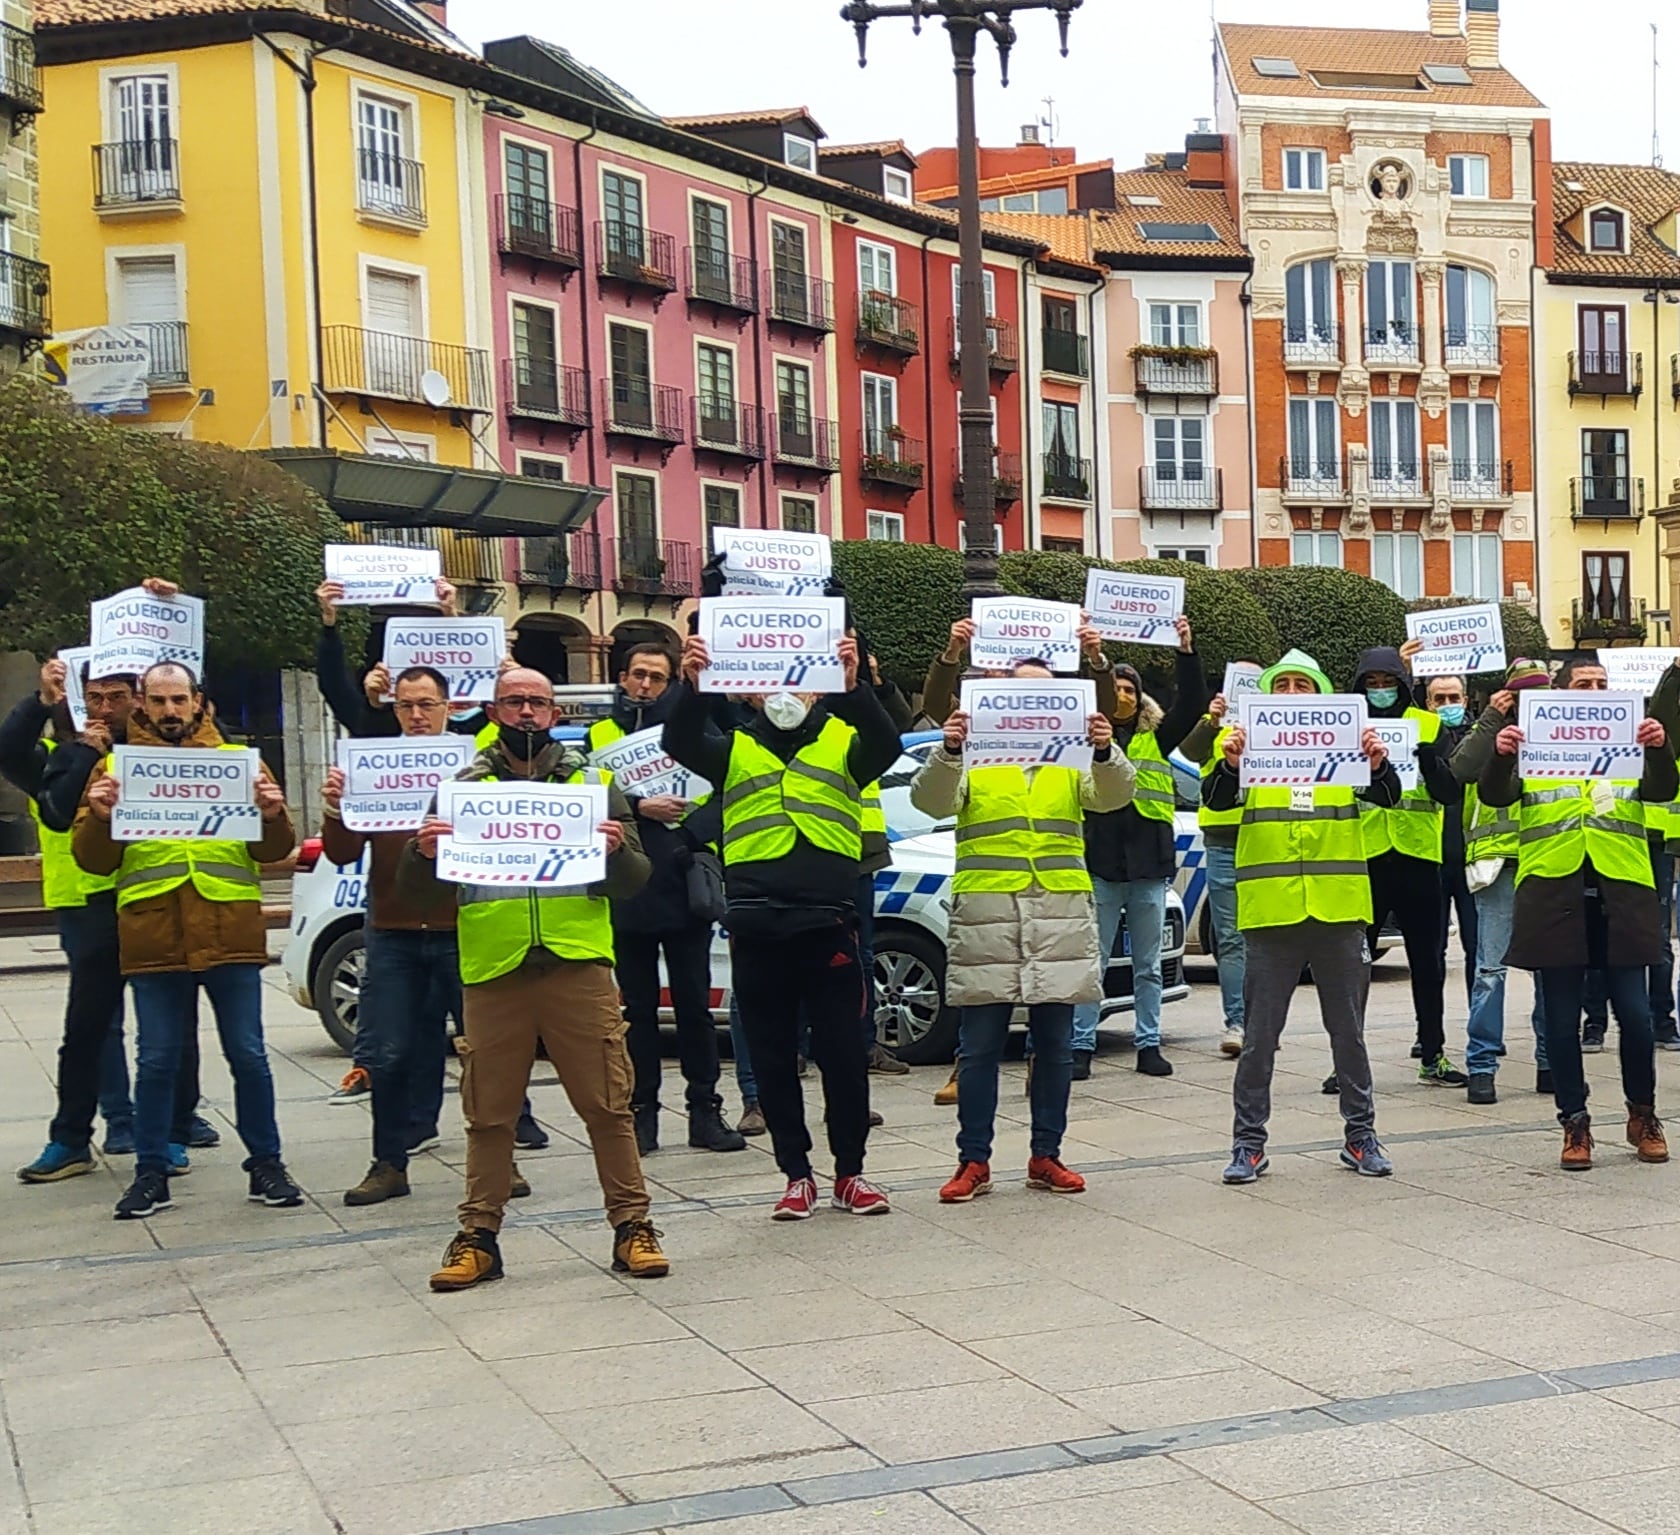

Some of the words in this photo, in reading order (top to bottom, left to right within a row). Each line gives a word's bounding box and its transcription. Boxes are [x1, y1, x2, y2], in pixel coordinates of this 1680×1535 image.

[730, 540, 814, 556] ACUERDO
[356, 563, 408, 573] JUSTO
[745, 556, 801, 571] JUSTO
[726, 575, 756, 585] olicía
[758, 578, 785, 589] Local
[1100, 583, 1170, 601] ACUERDO
[105, 603, 188, 624] ACUERDO
[1110, 599, 1157, 614] JUSTO
[719, 613, 822, 628] ACUERDO
[986, 608, 1065, 623] ACUERDO
[1118, 616, 1141, 628] Local
[116, 621, 170, 640] JUSTO
[998, 624, 1052, 638] JUSTO
[1419, 616, 1488, 634] ACUERDO
[393, 632, 489, 646] ACUERDO
[736, 633, 804, 648] JUSTO
[1432, 632, 1478, 647] JUSTO
[973, 643, 1007, 654] Policía
[1009, 644, 1035, 655] Local
[409, 651, 473, 664] JUSTO
[1413, 652, 1443, 664] Policía
[1444, 652, 1468, 663] Local
[751, 660, 785, 671] Local
[1623, 663, 1667, 672] JUSTO
[976, 695, 1079, 711] ACUERDO
[1256, 711, 1352, 726] ACUERDO
[1534, 706, 1627, 721] ACUERDO
[994, 716, 1062, 730] JUSTO
[1272, 731, 1335, 746] JUSTO
[1550, 726, 1610, 741] JUSTO
[965, 740, 1007, 751] Policía
[1009, 740, 1043, 750] Local
[356, 752, 459, 770] ACUERDO
[603, 741, 662, 771] ACUER
[1243, 757, 1283, 769] Policía
[1286, 758, 1316, 769] Local
[1521, 750, 1560, 762] Policía
[1562, 751, 1592, 762] Local
[131, 763, 241, 780] ACUERDO
[622, 757, 675, 786] JUSTO
[374, 773, 442, 790] JUSTO
[149, 784, 222, 799] JUSTO
[344, 800, 387, 813] Policía
[390, 800, 423, 812] Local
[460, 799, 584, 818] ACUERDO
[116, 807, 161, 821] Policía
[165, 809, 199, 822] Local
[480, 822, 562, 840] JUSTO
[442, 849, 493, 865] Policía
[498, 851, 537, 865] Local
